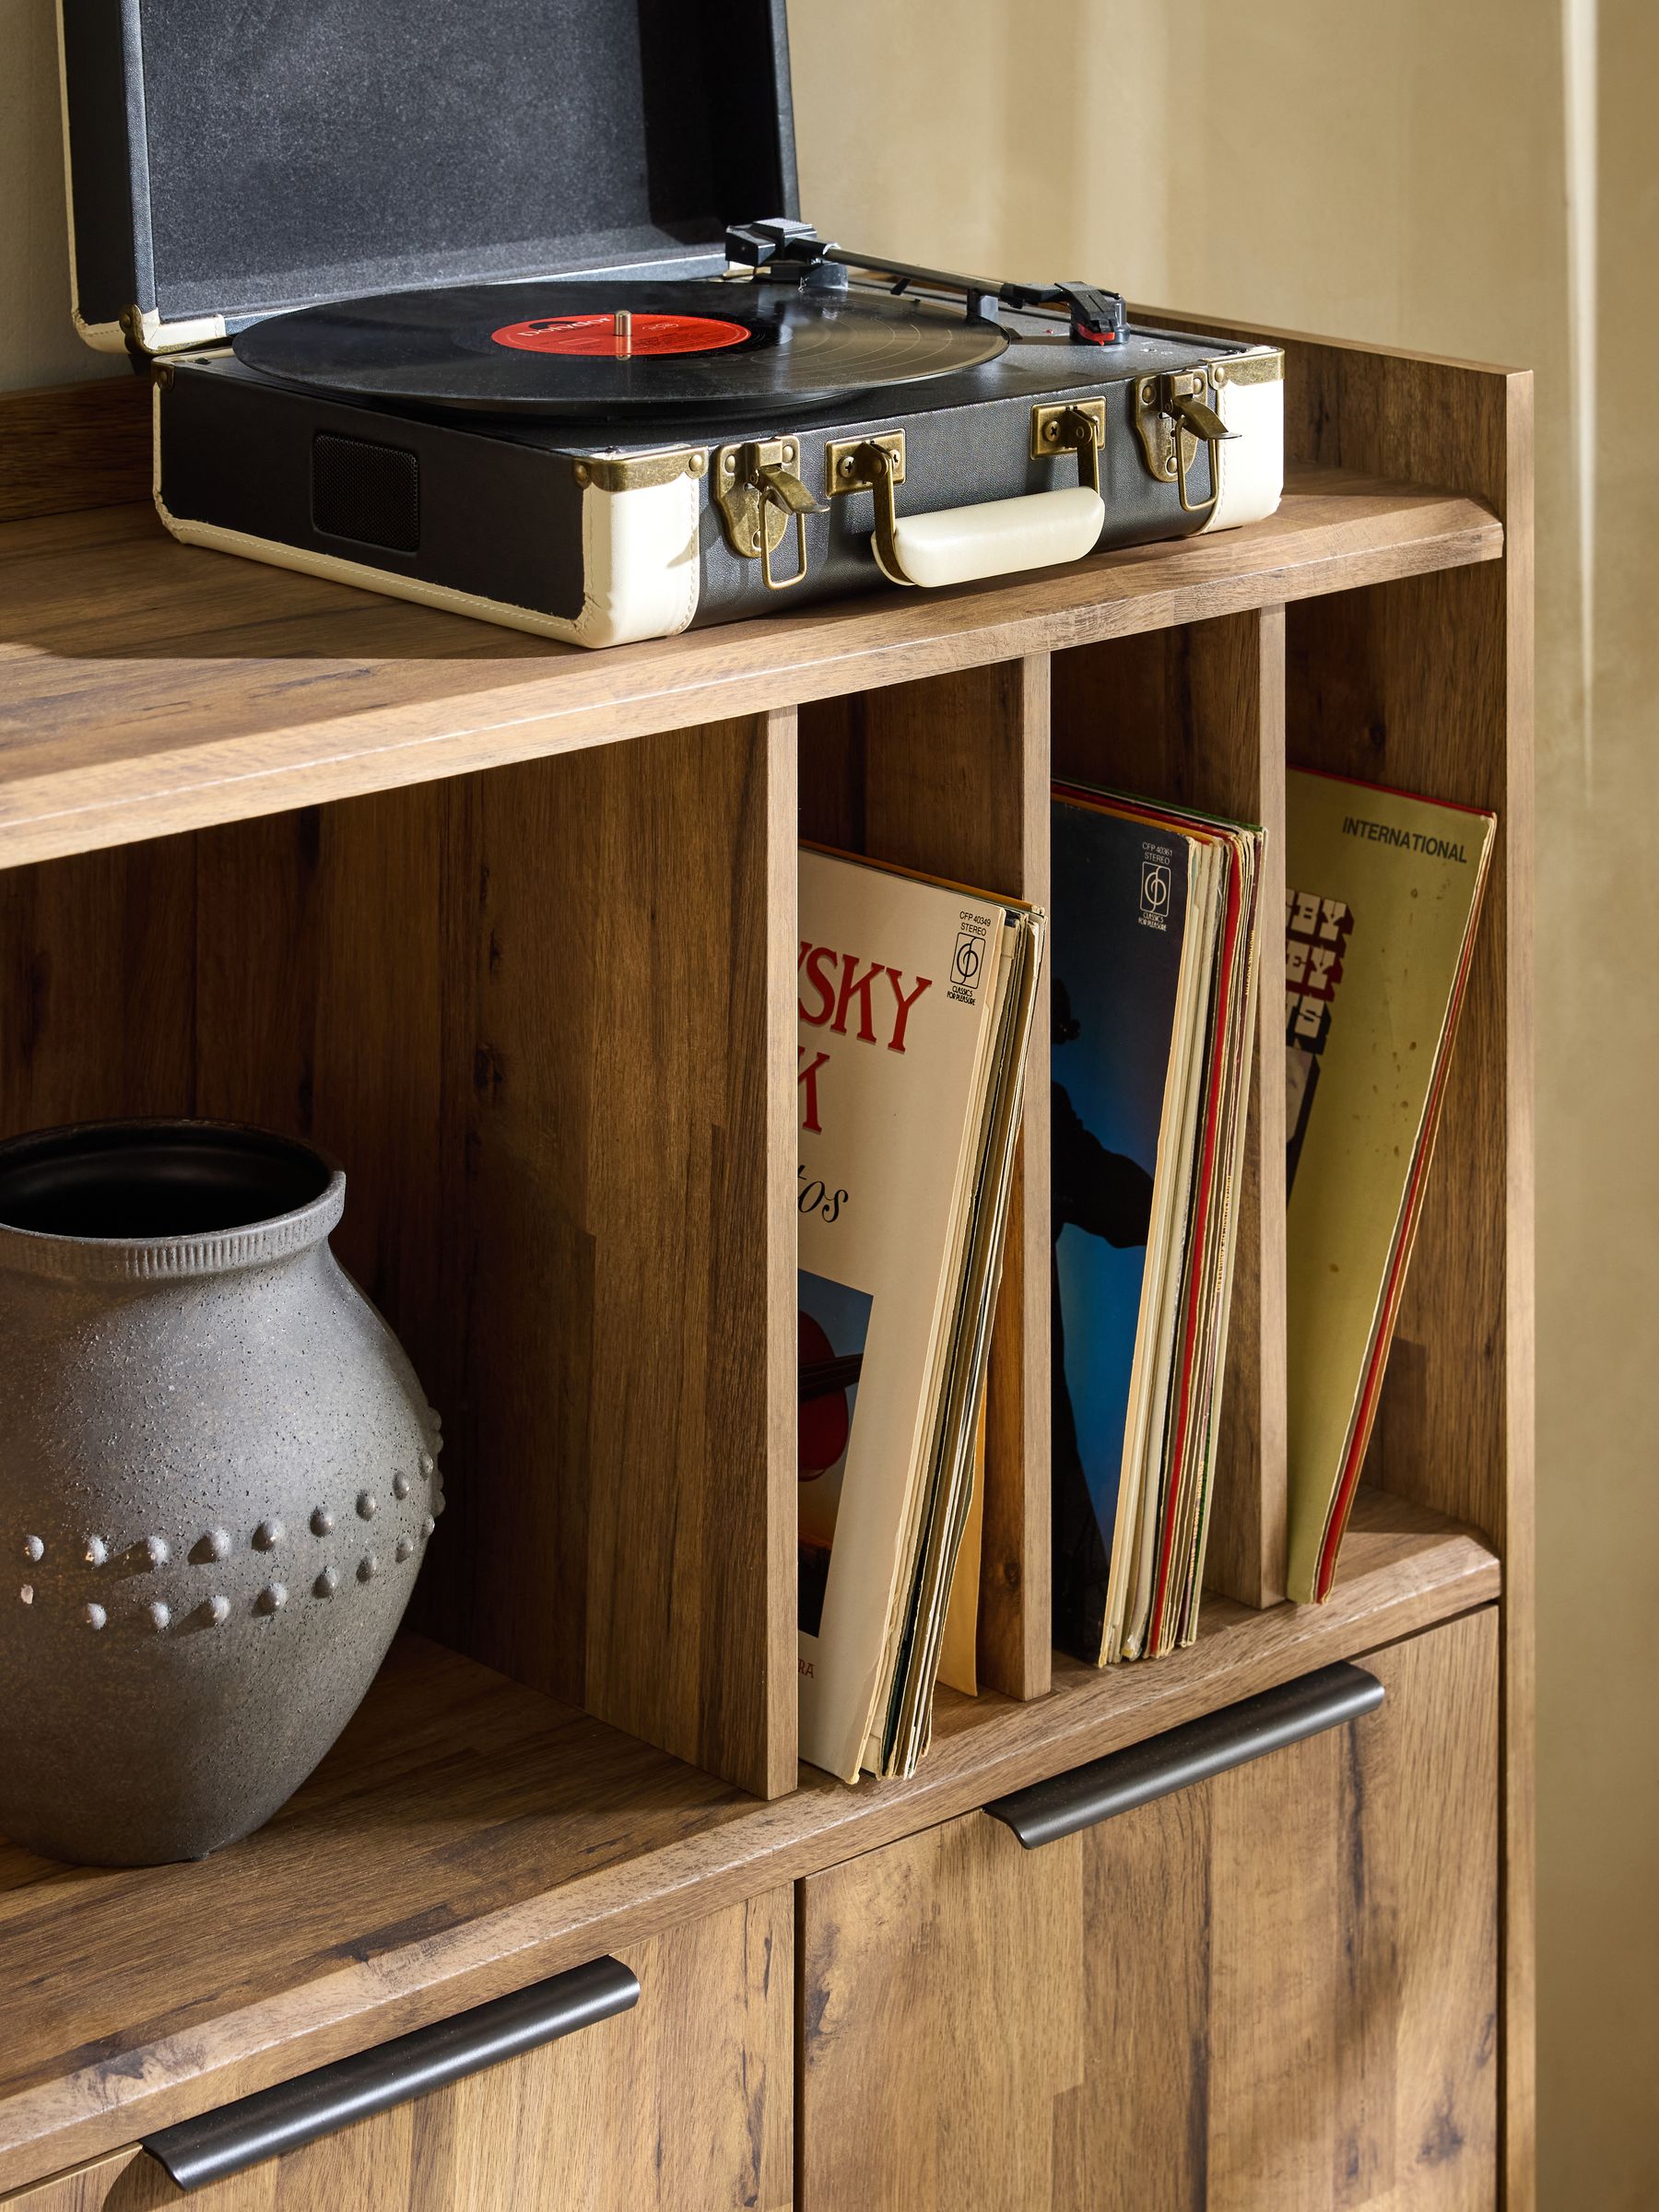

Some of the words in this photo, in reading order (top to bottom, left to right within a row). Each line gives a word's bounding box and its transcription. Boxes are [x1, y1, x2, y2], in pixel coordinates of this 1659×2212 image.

[1142, 841, 1156, 852] CFP
[1342, 816, 1467, 864] INTERNATIONAL
[1144, 852, 1171, 865] STEREO
[959, 911, 973, 921] CFP
[973, 915, 991, 927] 40349
[960, 922, 987, 936] STEREO
[952, 985, 973, 997] CLASSICS
[956, 994, 976, 1006] PLEASURE
